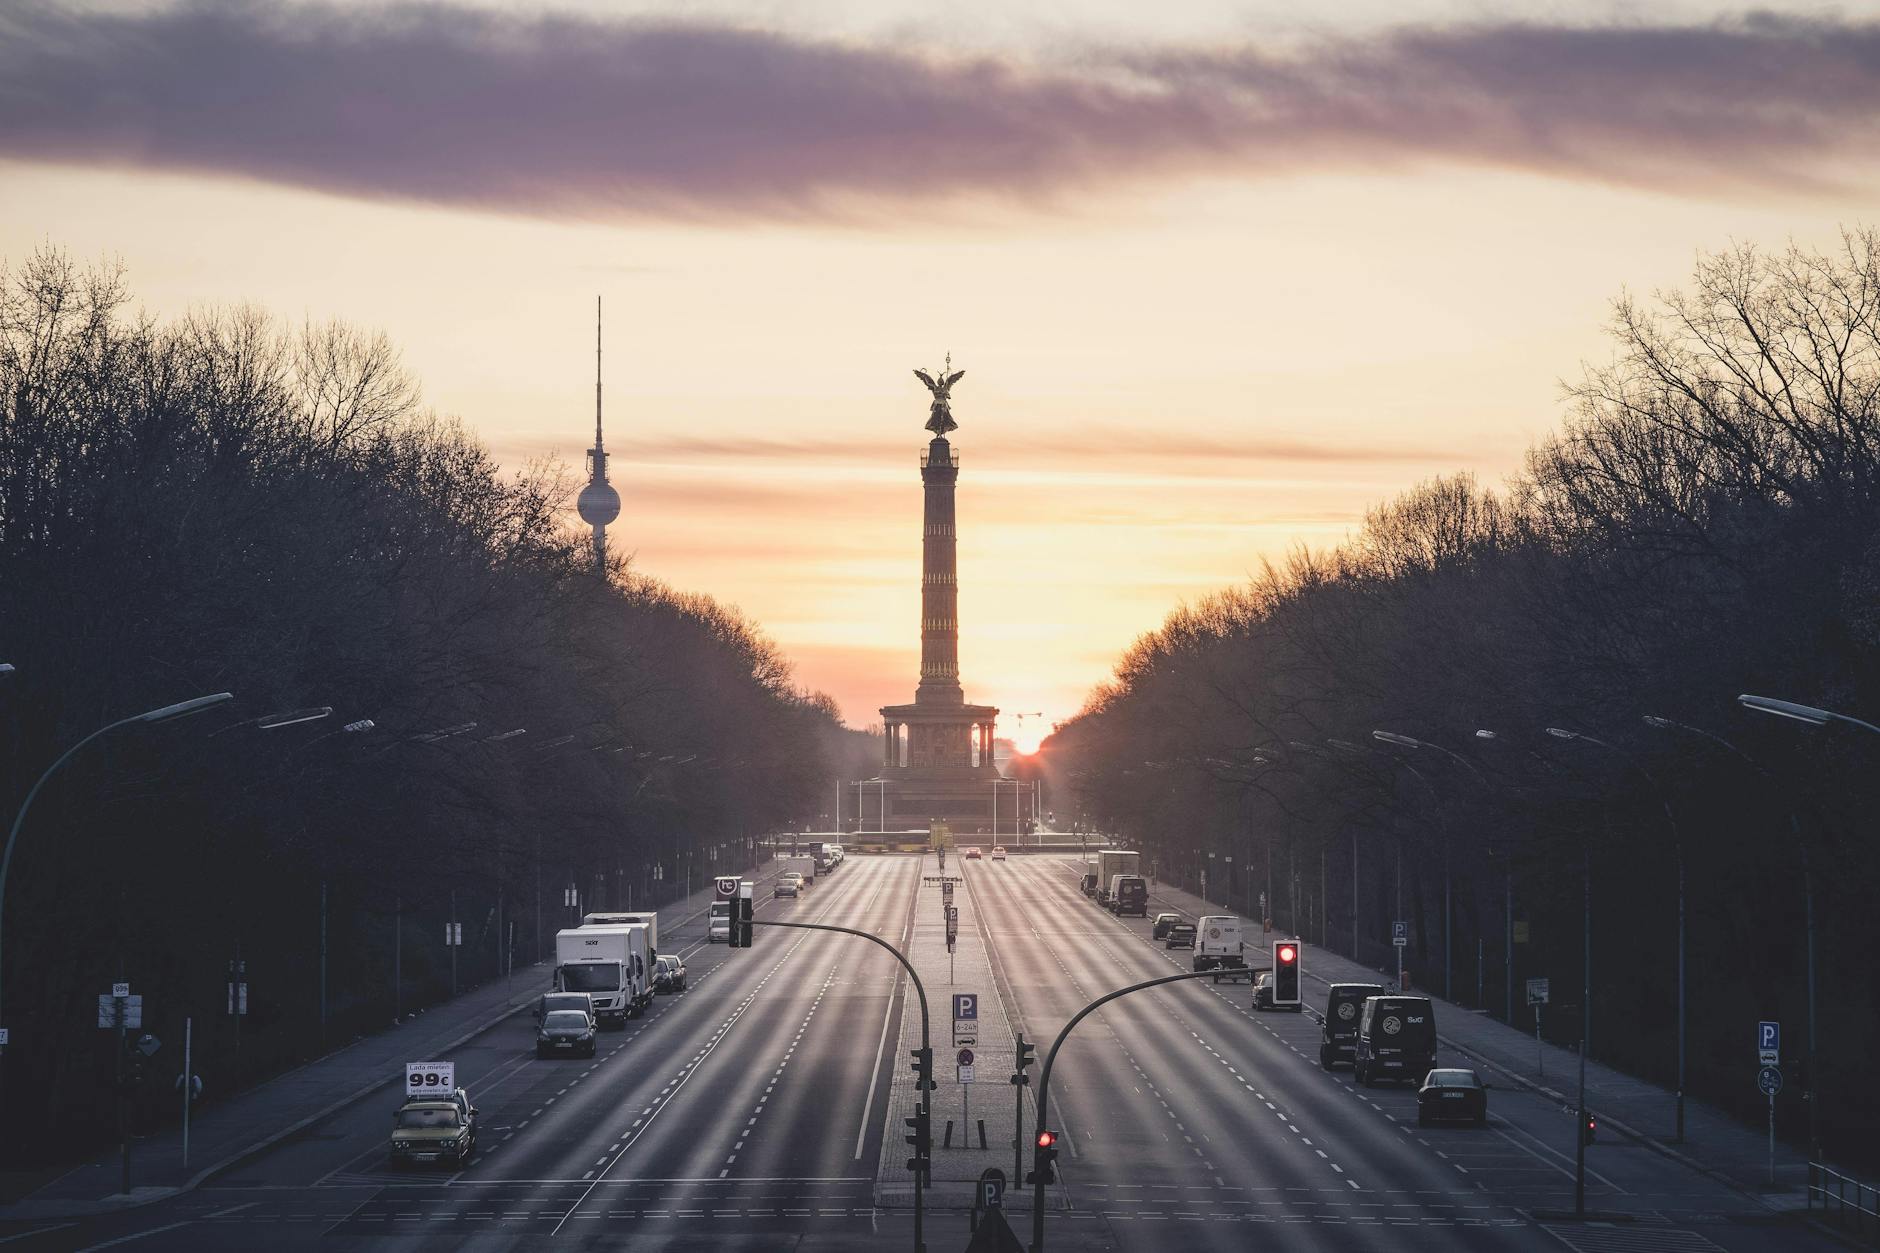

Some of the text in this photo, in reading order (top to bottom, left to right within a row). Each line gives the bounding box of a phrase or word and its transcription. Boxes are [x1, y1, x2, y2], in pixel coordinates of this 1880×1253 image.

[1395, 923, 1404, 937] P
[960, 997, 972, 1017] P
[1763, 1025, 1775, 1047] P
[985, 1184, 996, 1206] P
